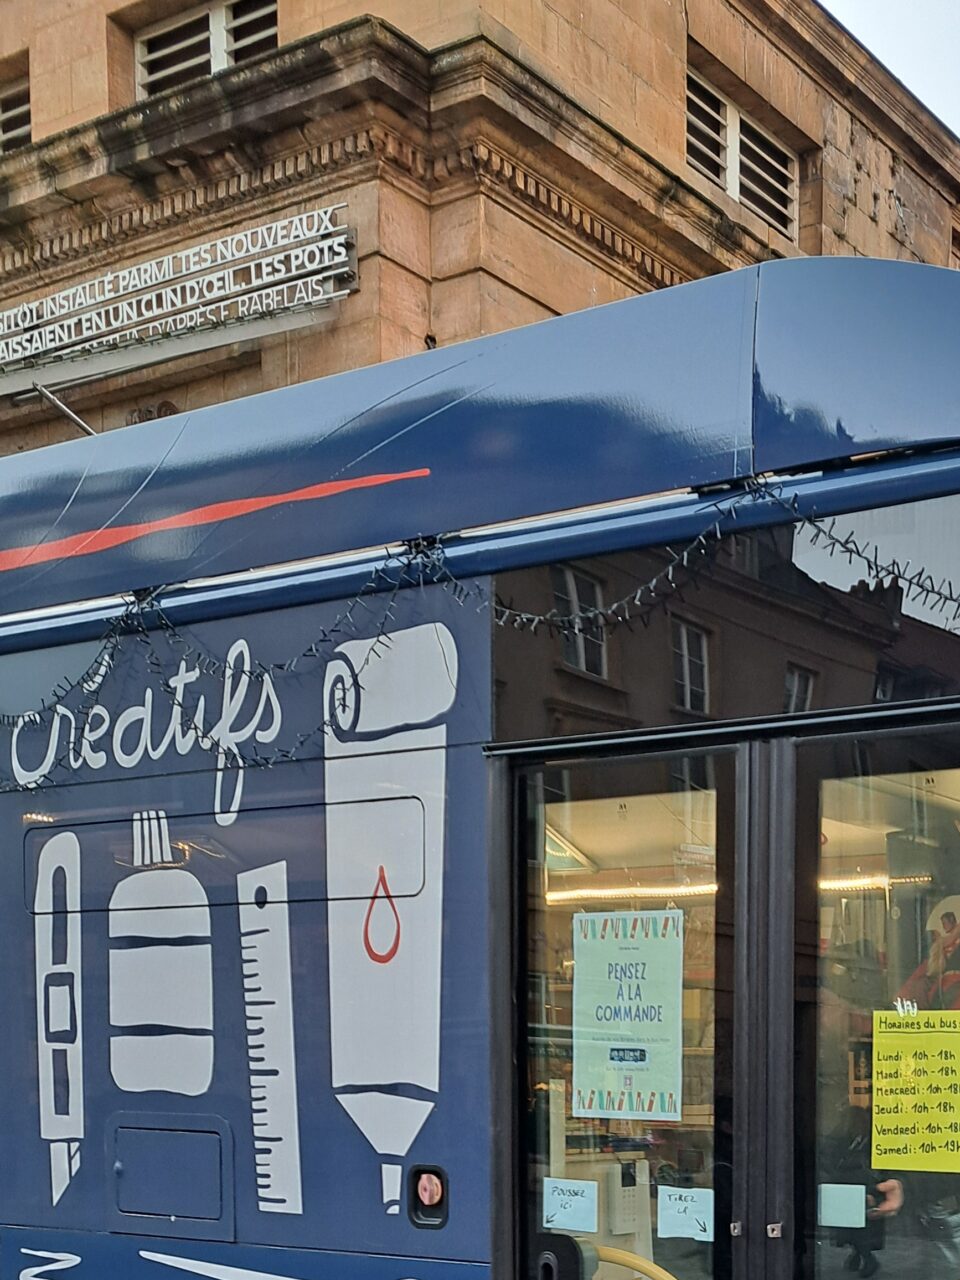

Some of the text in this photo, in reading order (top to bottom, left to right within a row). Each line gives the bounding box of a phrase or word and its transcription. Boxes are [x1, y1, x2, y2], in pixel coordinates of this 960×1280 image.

[43, 271, 114, 320] INSTALLÉ
[118, 254, 173, 296] PARMI
[216, 207, 335, 264] NOUVEAUX
[81, 308, 107, 335] EN
[109, 298, 138, 327] UN
[141, 284, 182, 317] CLIN
[250, 255, 286, 284] LES
[291, 236, 347, 274] POTS
[607, 962, 647, 981] PENSEZ
[628, 984, 643, 1001] LA
[595, 1005, 663, 1022] COMMANDE
[879, 1016, 921, 1030] Horaires
[923, 1016, 936, 1029] du
